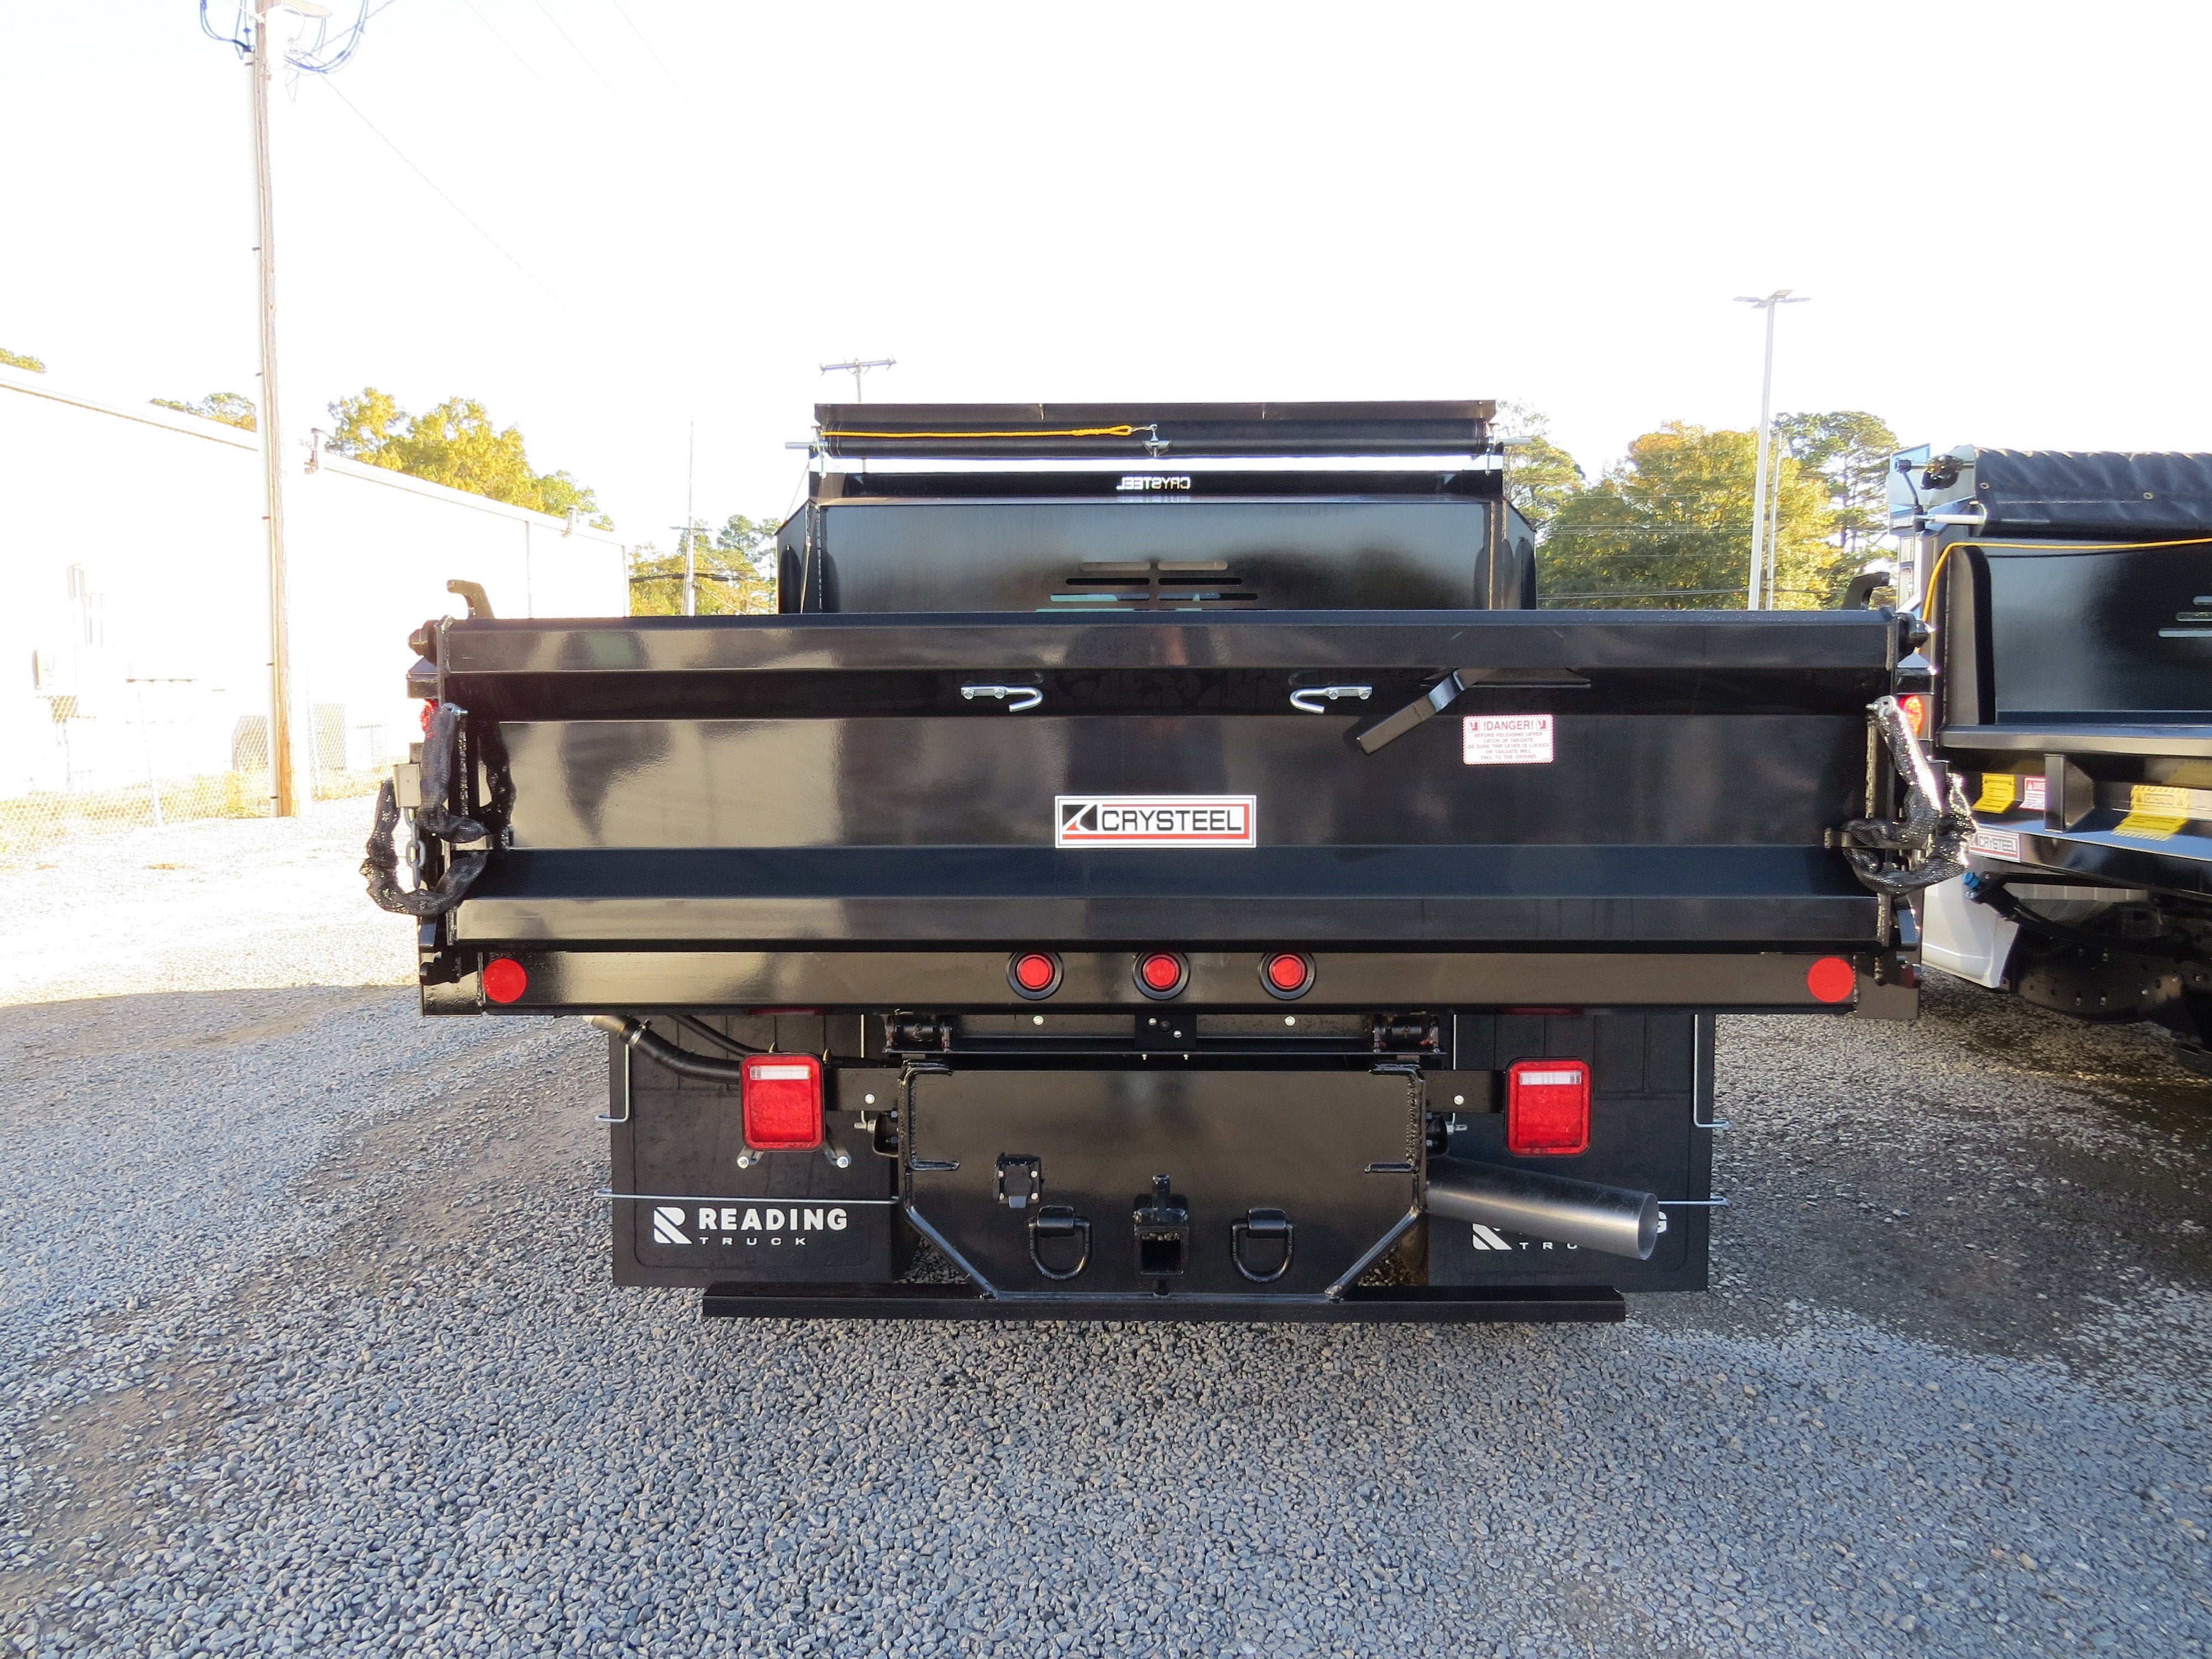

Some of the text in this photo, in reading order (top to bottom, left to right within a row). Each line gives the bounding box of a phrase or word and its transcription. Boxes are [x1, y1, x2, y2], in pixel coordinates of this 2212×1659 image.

[1102, 810, 1241, 831] CRYSTEEL
[1979, 836, 2016, 852] CRYSTEEL
[698, 1208, 847, 1230] READING
[700, 1237, 806, 1245] TRUCK
[1519, 1241, 1578, 1250] TRU
